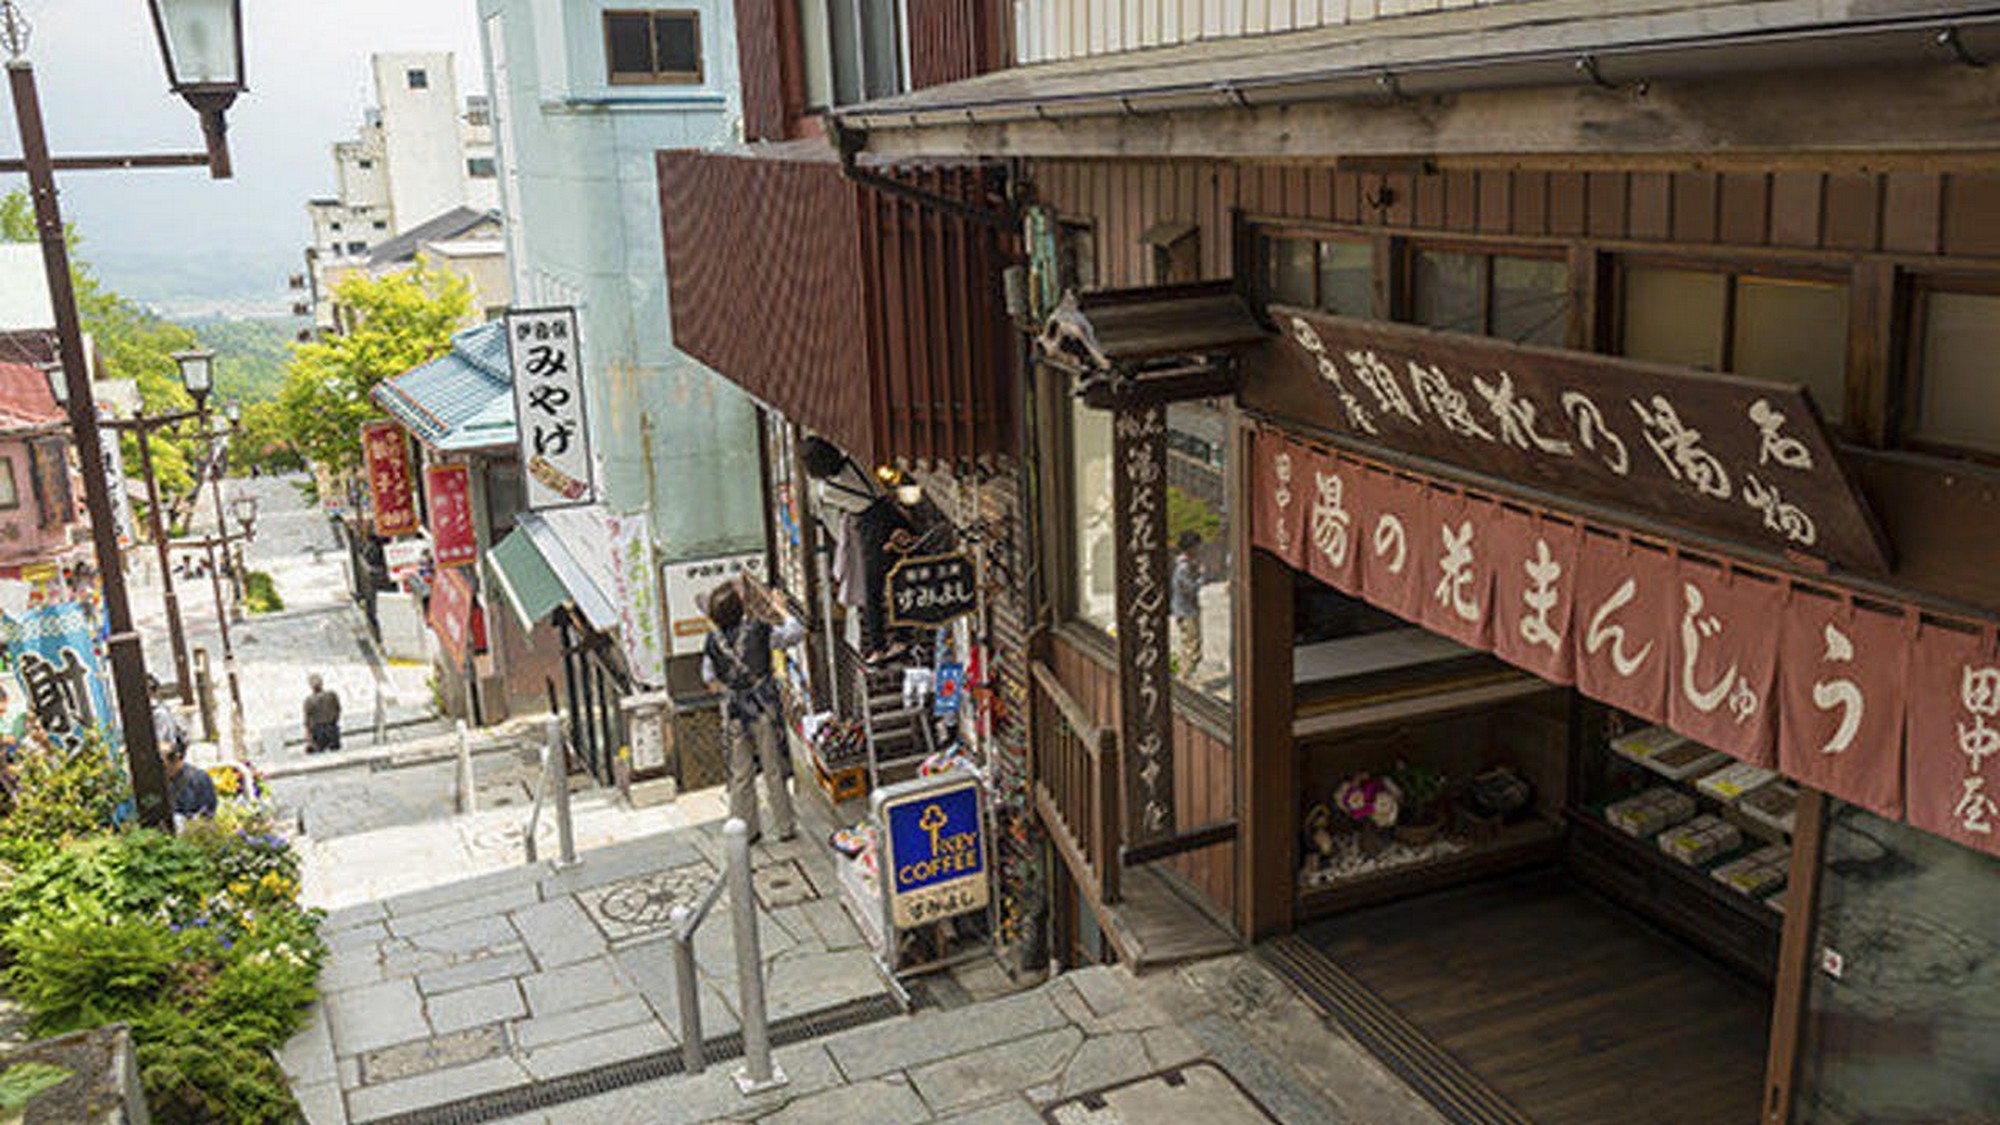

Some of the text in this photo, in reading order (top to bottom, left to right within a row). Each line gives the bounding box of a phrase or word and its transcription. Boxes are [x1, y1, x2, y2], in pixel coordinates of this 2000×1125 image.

[525, 344, 577, 456] みやげ
[1742, 398, 1816, 547] 名物
[1312, 470, 1865, 755] 湯の花まんじゅう
[1954, 664, 2000, 835] 田中屋
[899, 850, 977, 885] COFFEE
[940, 832, 977, 852] KEY
